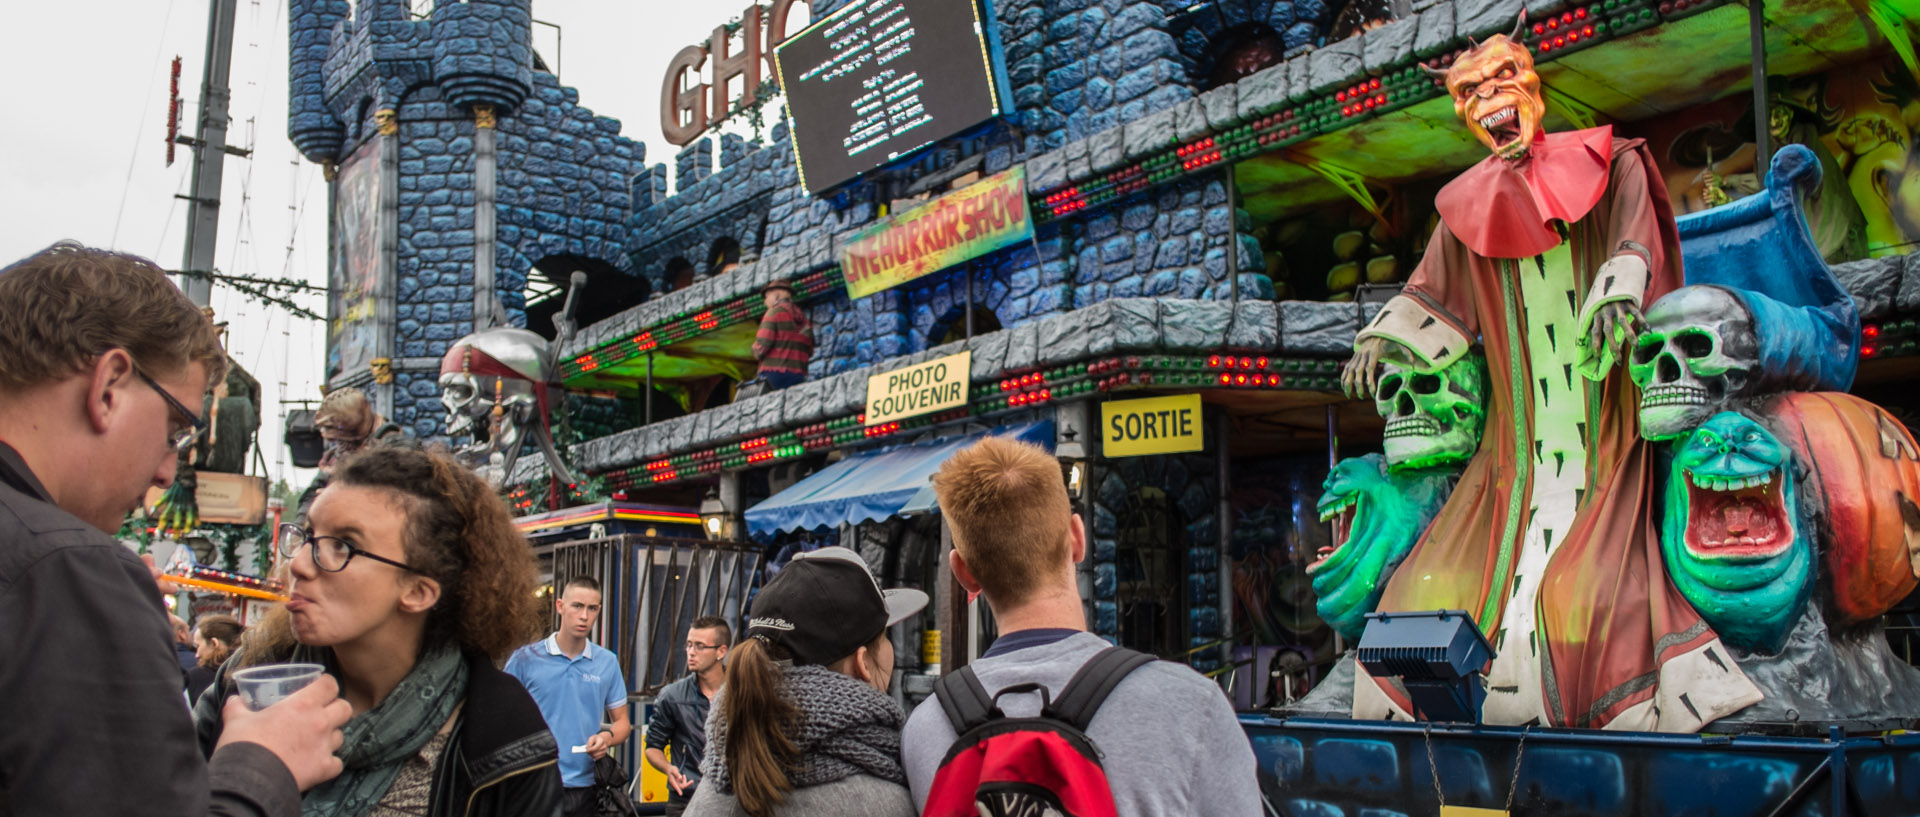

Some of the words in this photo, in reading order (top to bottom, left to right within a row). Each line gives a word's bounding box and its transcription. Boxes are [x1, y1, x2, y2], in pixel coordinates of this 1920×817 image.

[961, 177, 1025, 242] SHOW
[888, 362, 947, 394] PHOTO
[871, 381, 961, 418] SOUVENIR
[1111, 408, 1193, 442] SORTIE
